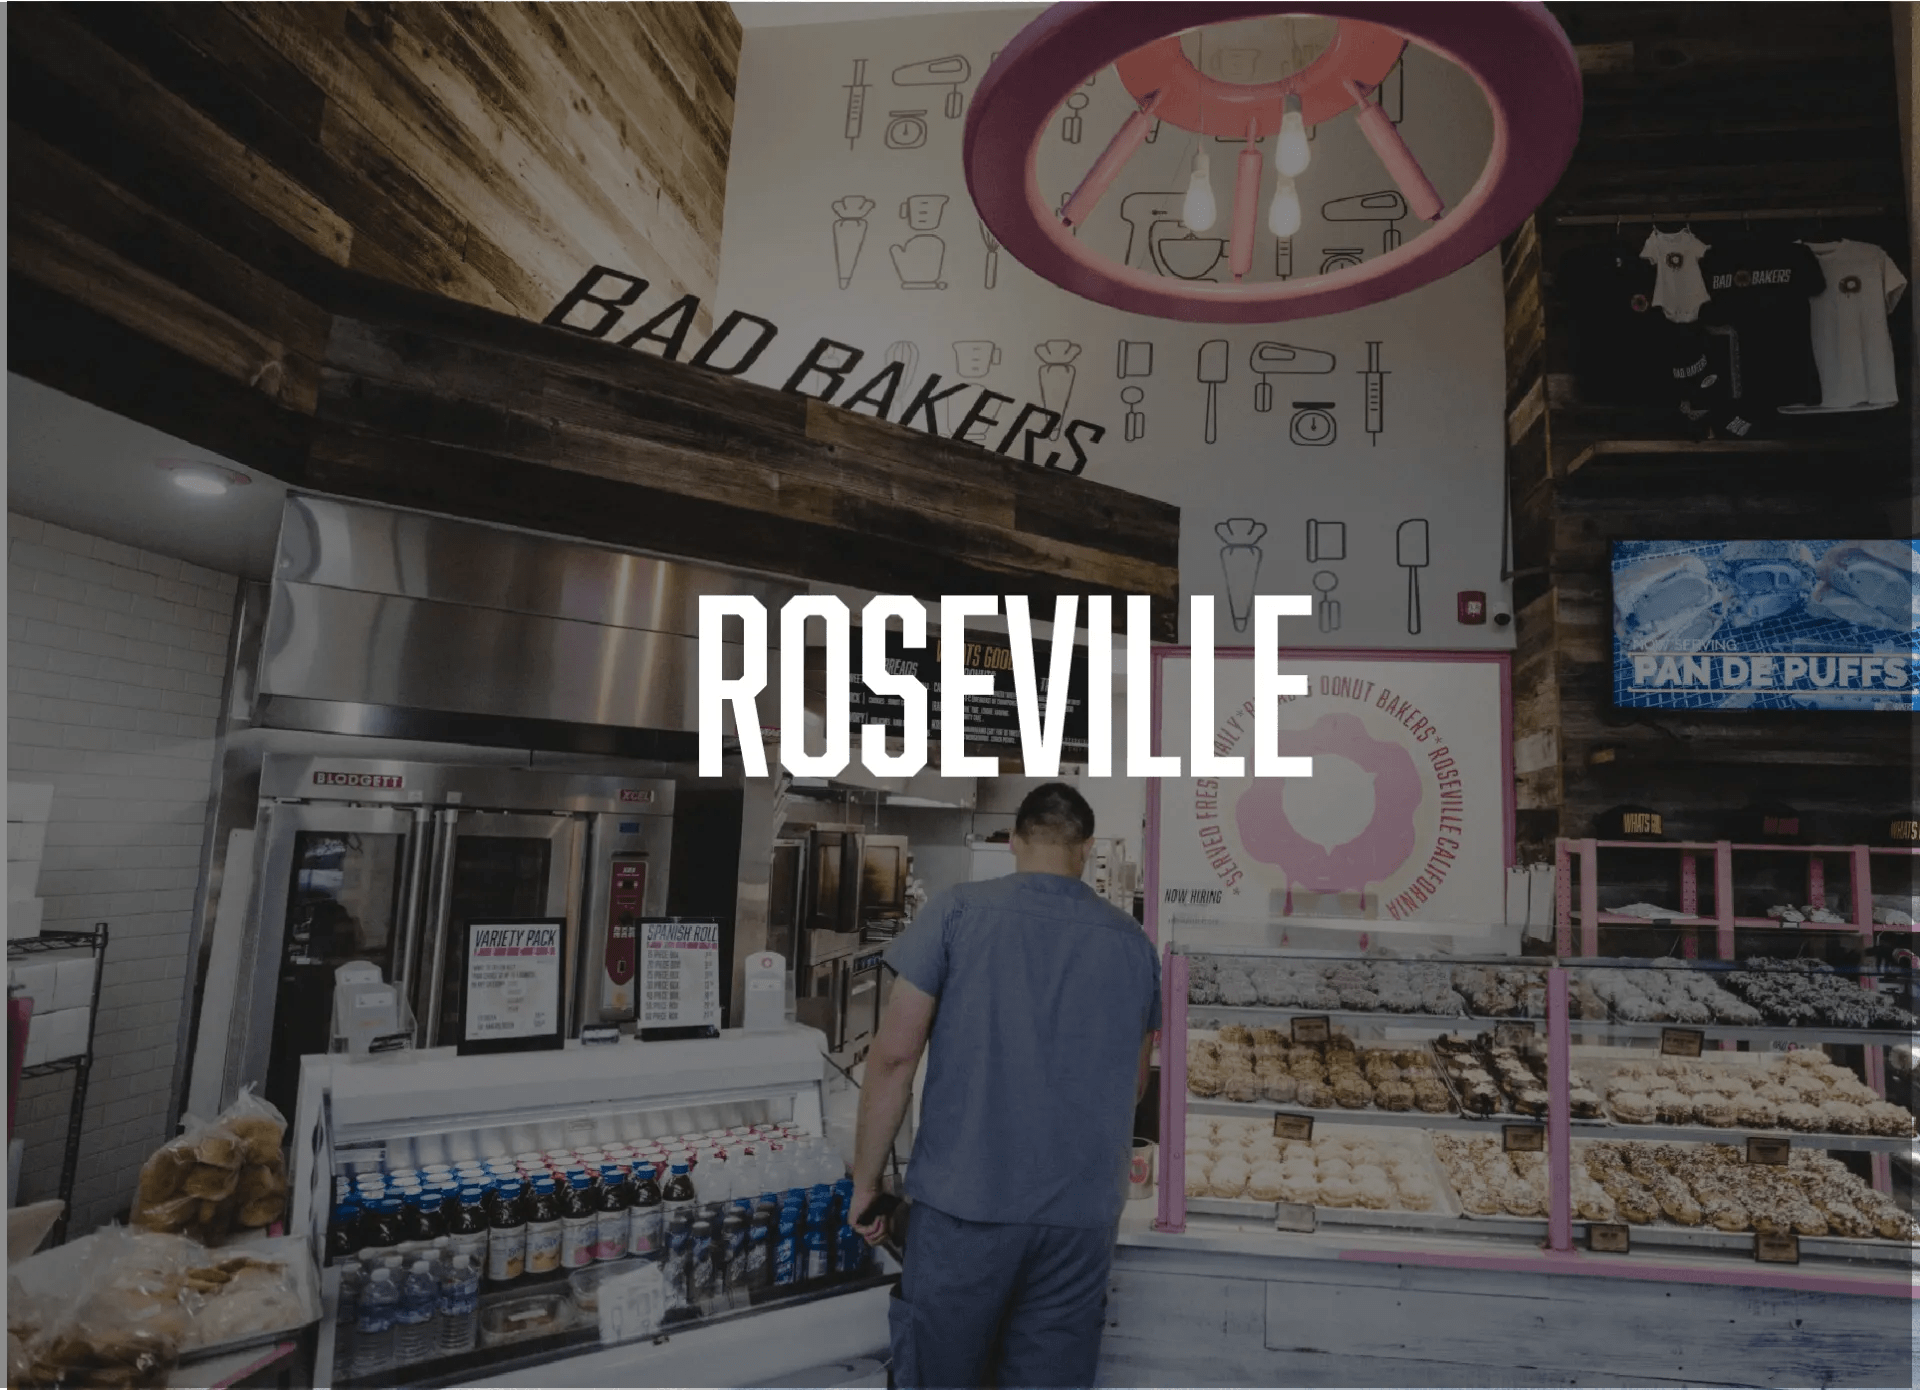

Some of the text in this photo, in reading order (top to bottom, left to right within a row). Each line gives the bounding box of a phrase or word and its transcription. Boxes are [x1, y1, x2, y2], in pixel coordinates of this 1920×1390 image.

[1713, 269, 1792, 289] BAD BAKERS
[542, 264, 1106, 477] BAD BAKERS
[1633, 639, 1669, 651] NOW
[1635, 656, 1909, 688] PAN DE PUFFS
[1320, 675, 1375, 702] DONUT
[1376, 688, 1437, 742] BAKERS
[315, 772, 401, 788] BLODGETT
[1195, 716, 1245, 887] SERVED FRES AILY
[1385, 746, 1464, 920] ROSEVILLE CALIFORNIA
[1164, 888, 1223, 904] NOW HIRING
[475, 929, 557, 947] VARIETY PACK
[647, 924, 718, 942] SPANISH ROLL
